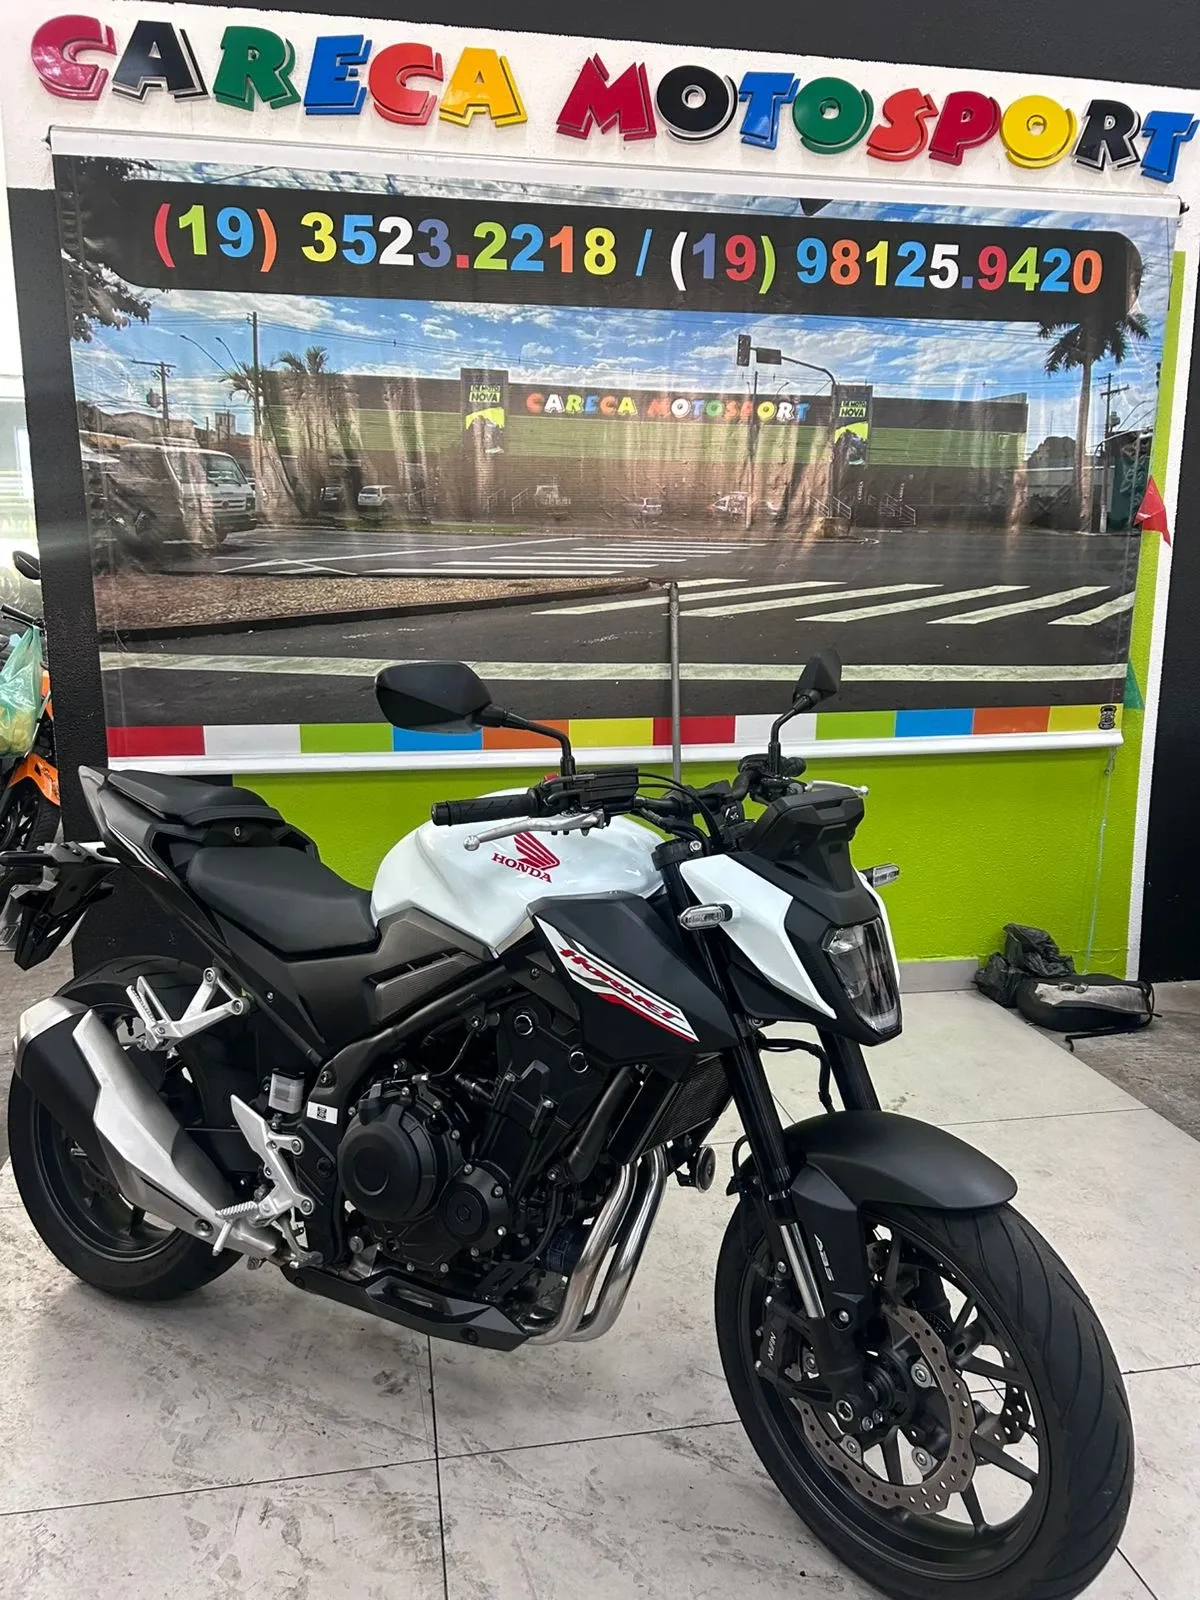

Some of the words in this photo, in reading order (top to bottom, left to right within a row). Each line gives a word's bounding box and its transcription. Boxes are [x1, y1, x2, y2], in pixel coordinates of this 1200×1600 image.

[30, 14, 528, 127] CARECA
[556, 53, 1199, 183] MOTOSPORT
[153, 203, 277, 272] (19)
[300, 212, 617, 275] 3523.2218
[669, 231, 776, 294] (19)
[796, 238, 1102, 292] 98125.9420
[526, 393, 638, 416] CARECA
[647, 398, 809, 422] MOTOSPORT
[841, 407, 864, 417] NOVA
[491, 852, 553, 883] HONDA
